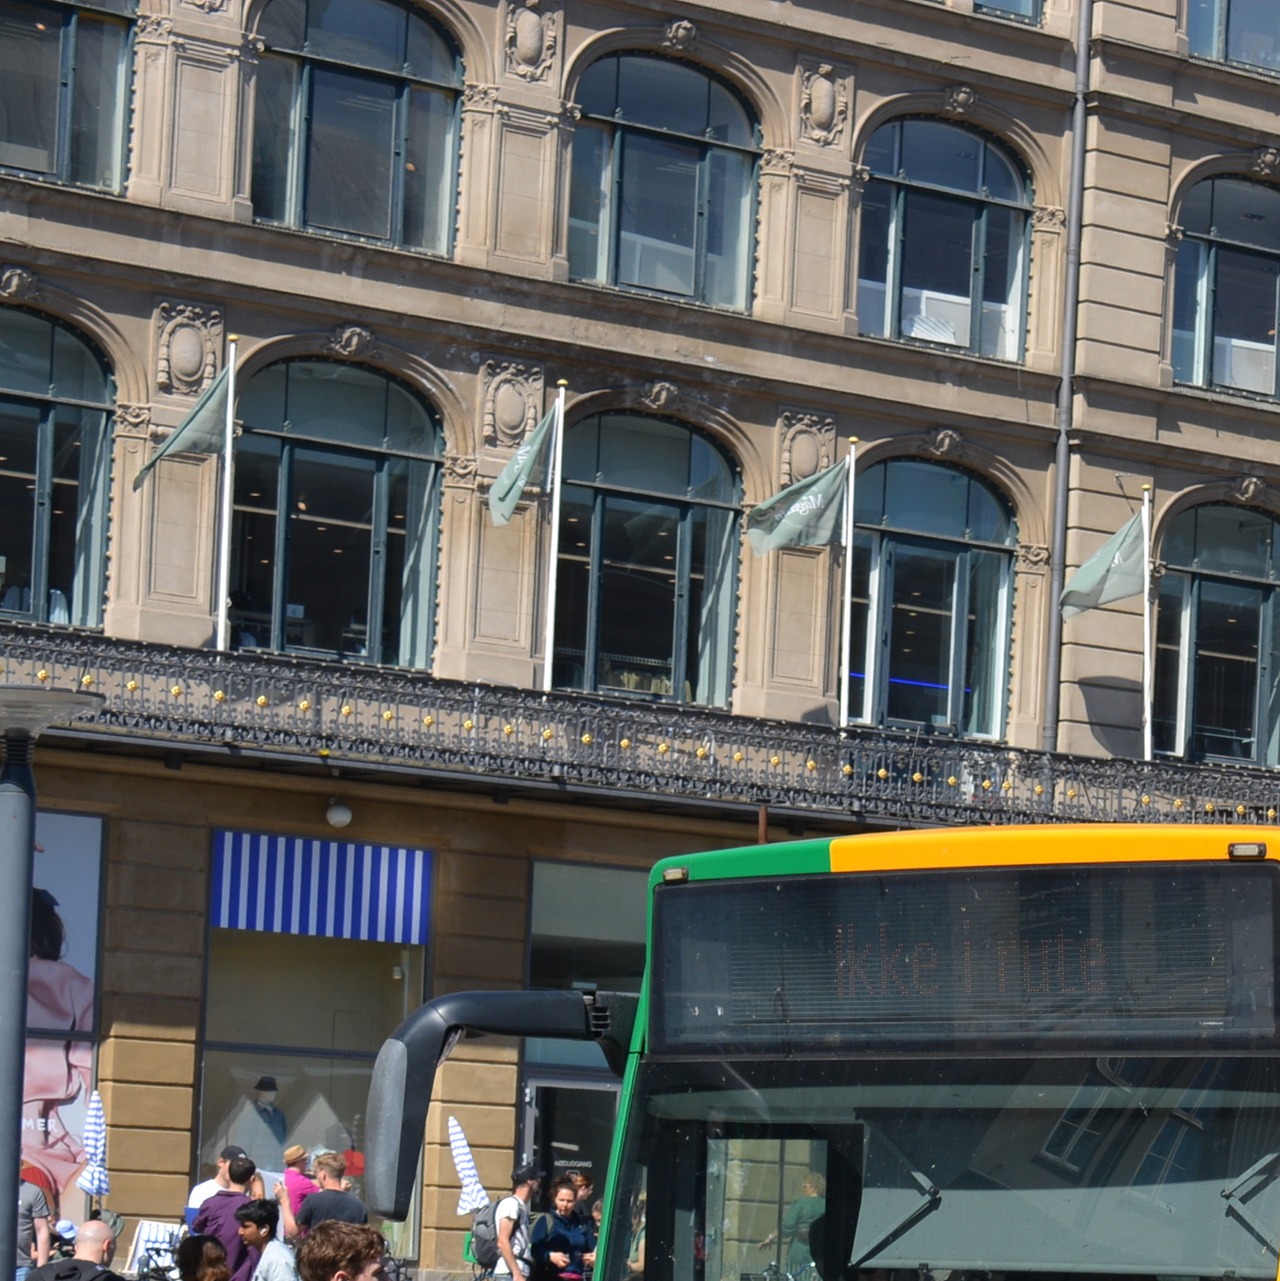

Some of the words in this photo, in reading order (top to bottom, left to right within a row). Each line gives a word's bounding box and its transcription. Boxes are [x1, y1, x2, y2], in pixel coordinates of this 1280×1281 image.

[836, 922, 938, 996] Ikke
[998, 928, 1107, 993] rute
[22, 1118, 58, 1132] MER
